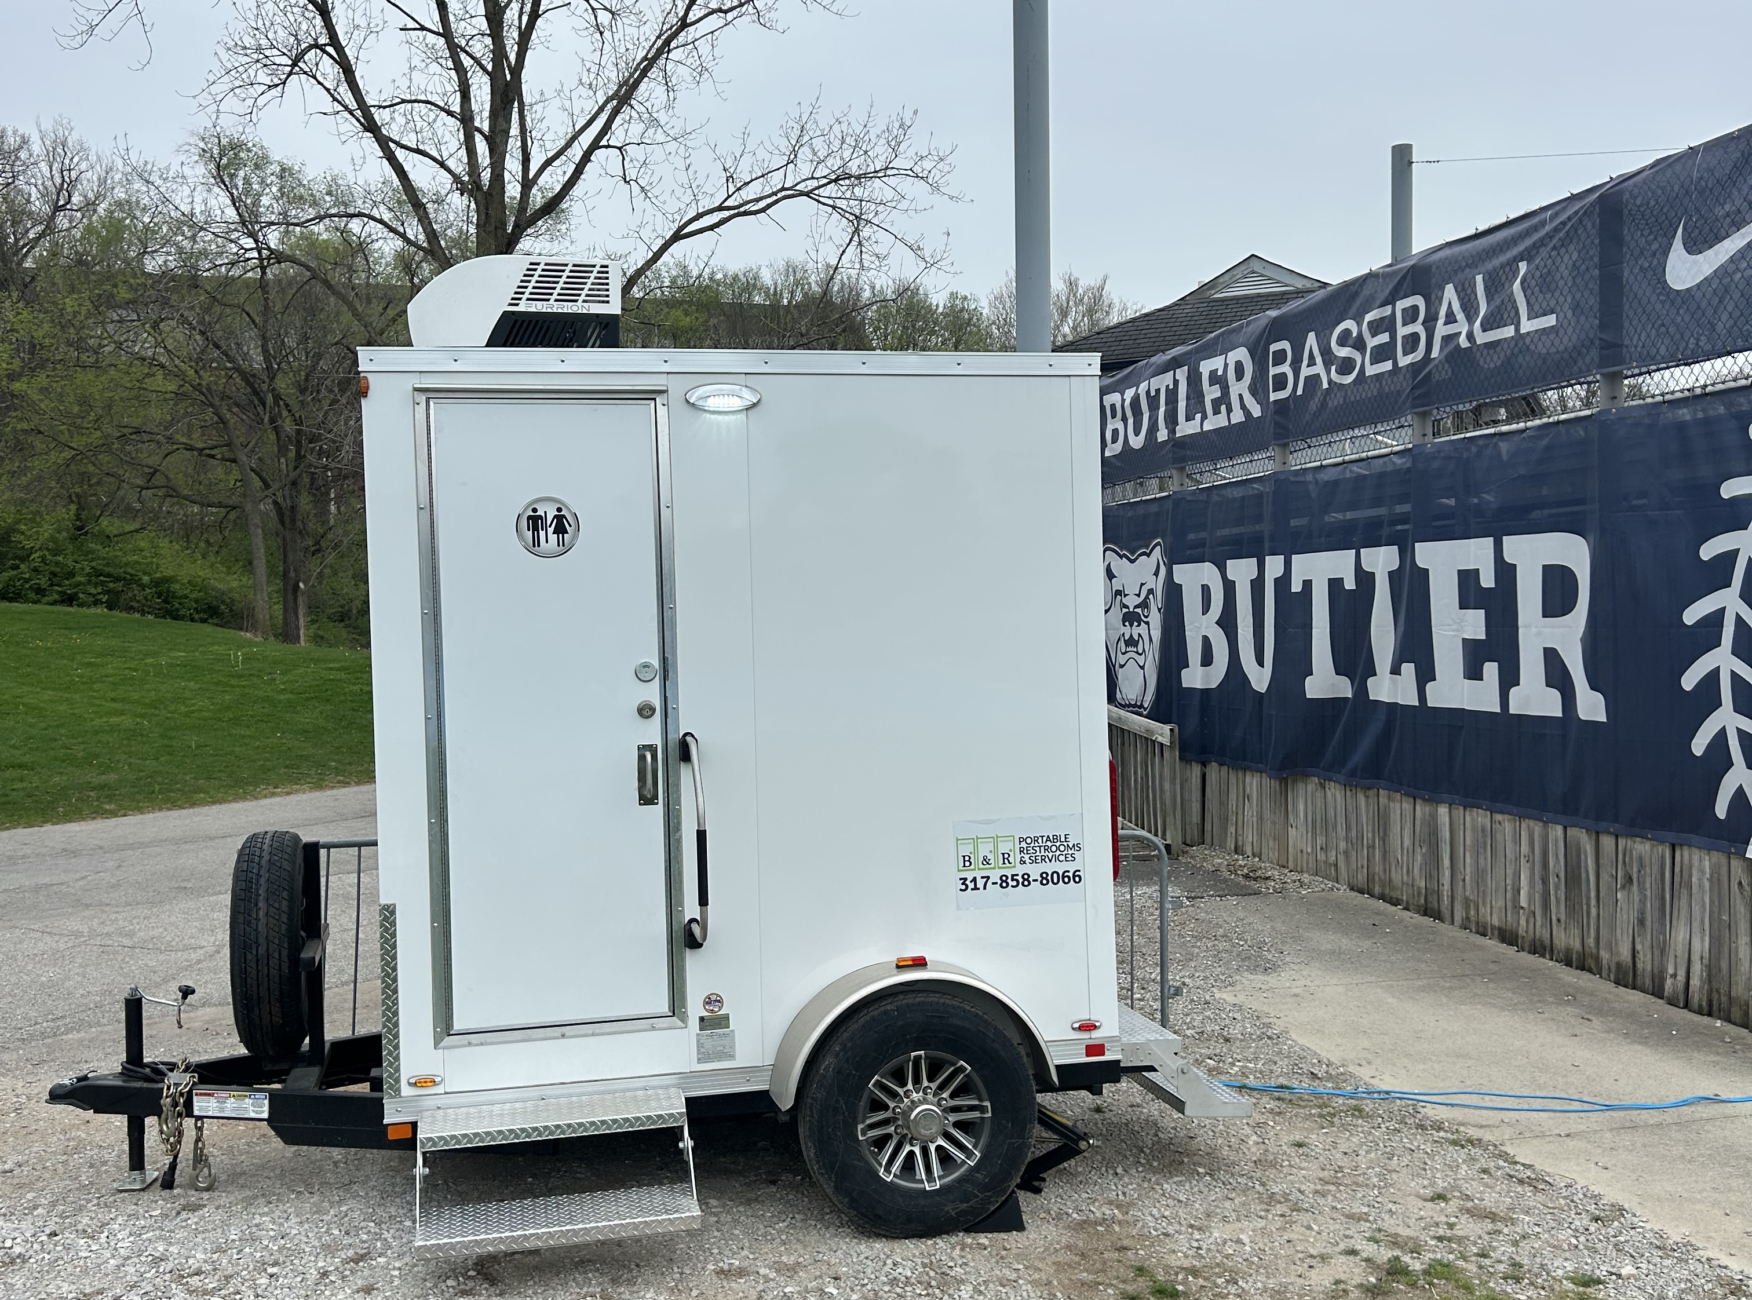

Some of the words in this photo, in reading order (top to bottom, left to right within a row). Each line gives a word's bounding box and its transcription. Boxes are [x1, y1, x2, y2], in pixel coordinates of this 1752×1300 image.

[524, 303, 591, 312] FURRION
[1103, 346, 1262, 457] BUTLER
[1269, 260, 1557, 402] BASEBALL
[1173, 532, 1607, 722] BUTLER
[1018, 834, 1070, 845] PORTABLE
[1019, 843, 1082, 855] RESTROOMS
[961, 854, 973, 868] B
[981, 855, 992, 866] &
[1001, 852, 1012, 865] R
[1019, 856, 1027, 865] &
[1028, 853, 1076, 864] SERVICES
[959, 869, 1082, 892] 317-858-8066
